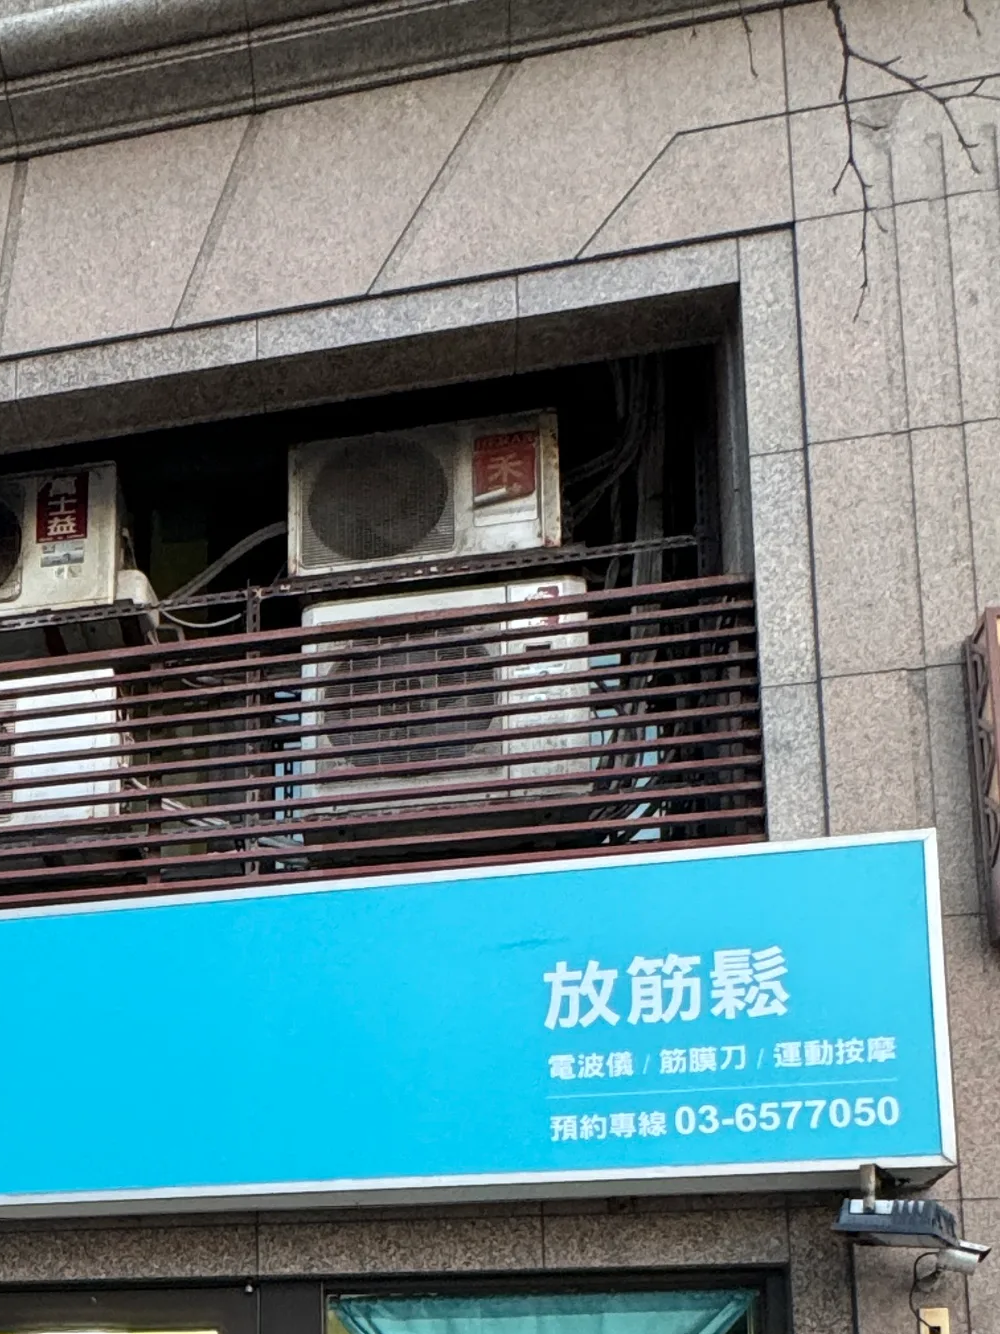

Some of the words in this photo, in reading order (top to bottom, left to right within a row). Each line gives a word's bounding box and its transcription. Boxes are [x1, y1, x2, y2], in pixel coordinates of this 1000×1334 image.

[543, 945, 791, 1030] 放筋鬆
[548, 1049, 634, 1080] 電波儀
[659, 1045, 747, 1075] 筋膜刀
[774, 1036, 898, 1068] 運動按摩
[549, 1110, 667, 1142] 預約專線
[674, 1096, 900, 1135] 03-6577050
